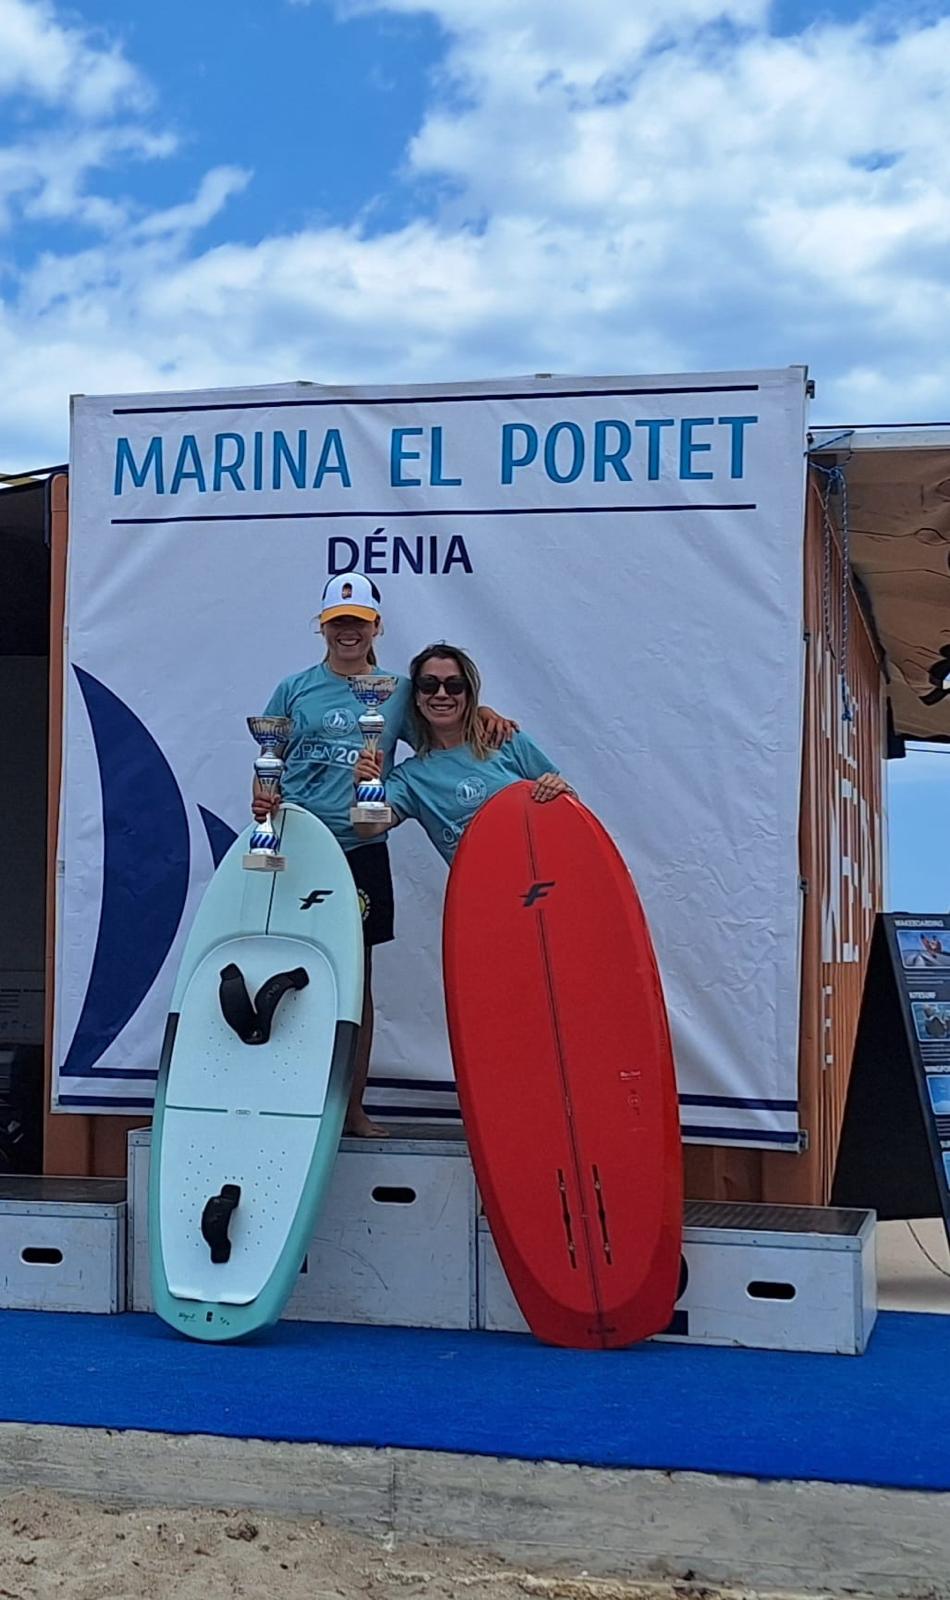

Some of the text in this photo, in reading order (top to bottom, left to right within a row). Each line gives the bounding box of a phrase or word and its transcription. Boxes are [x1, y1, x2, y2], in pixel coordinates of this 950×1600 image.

[114, 416, 758, 496] MARINA EL PORTET
[328, 528, 474, 575] DÉNIA
